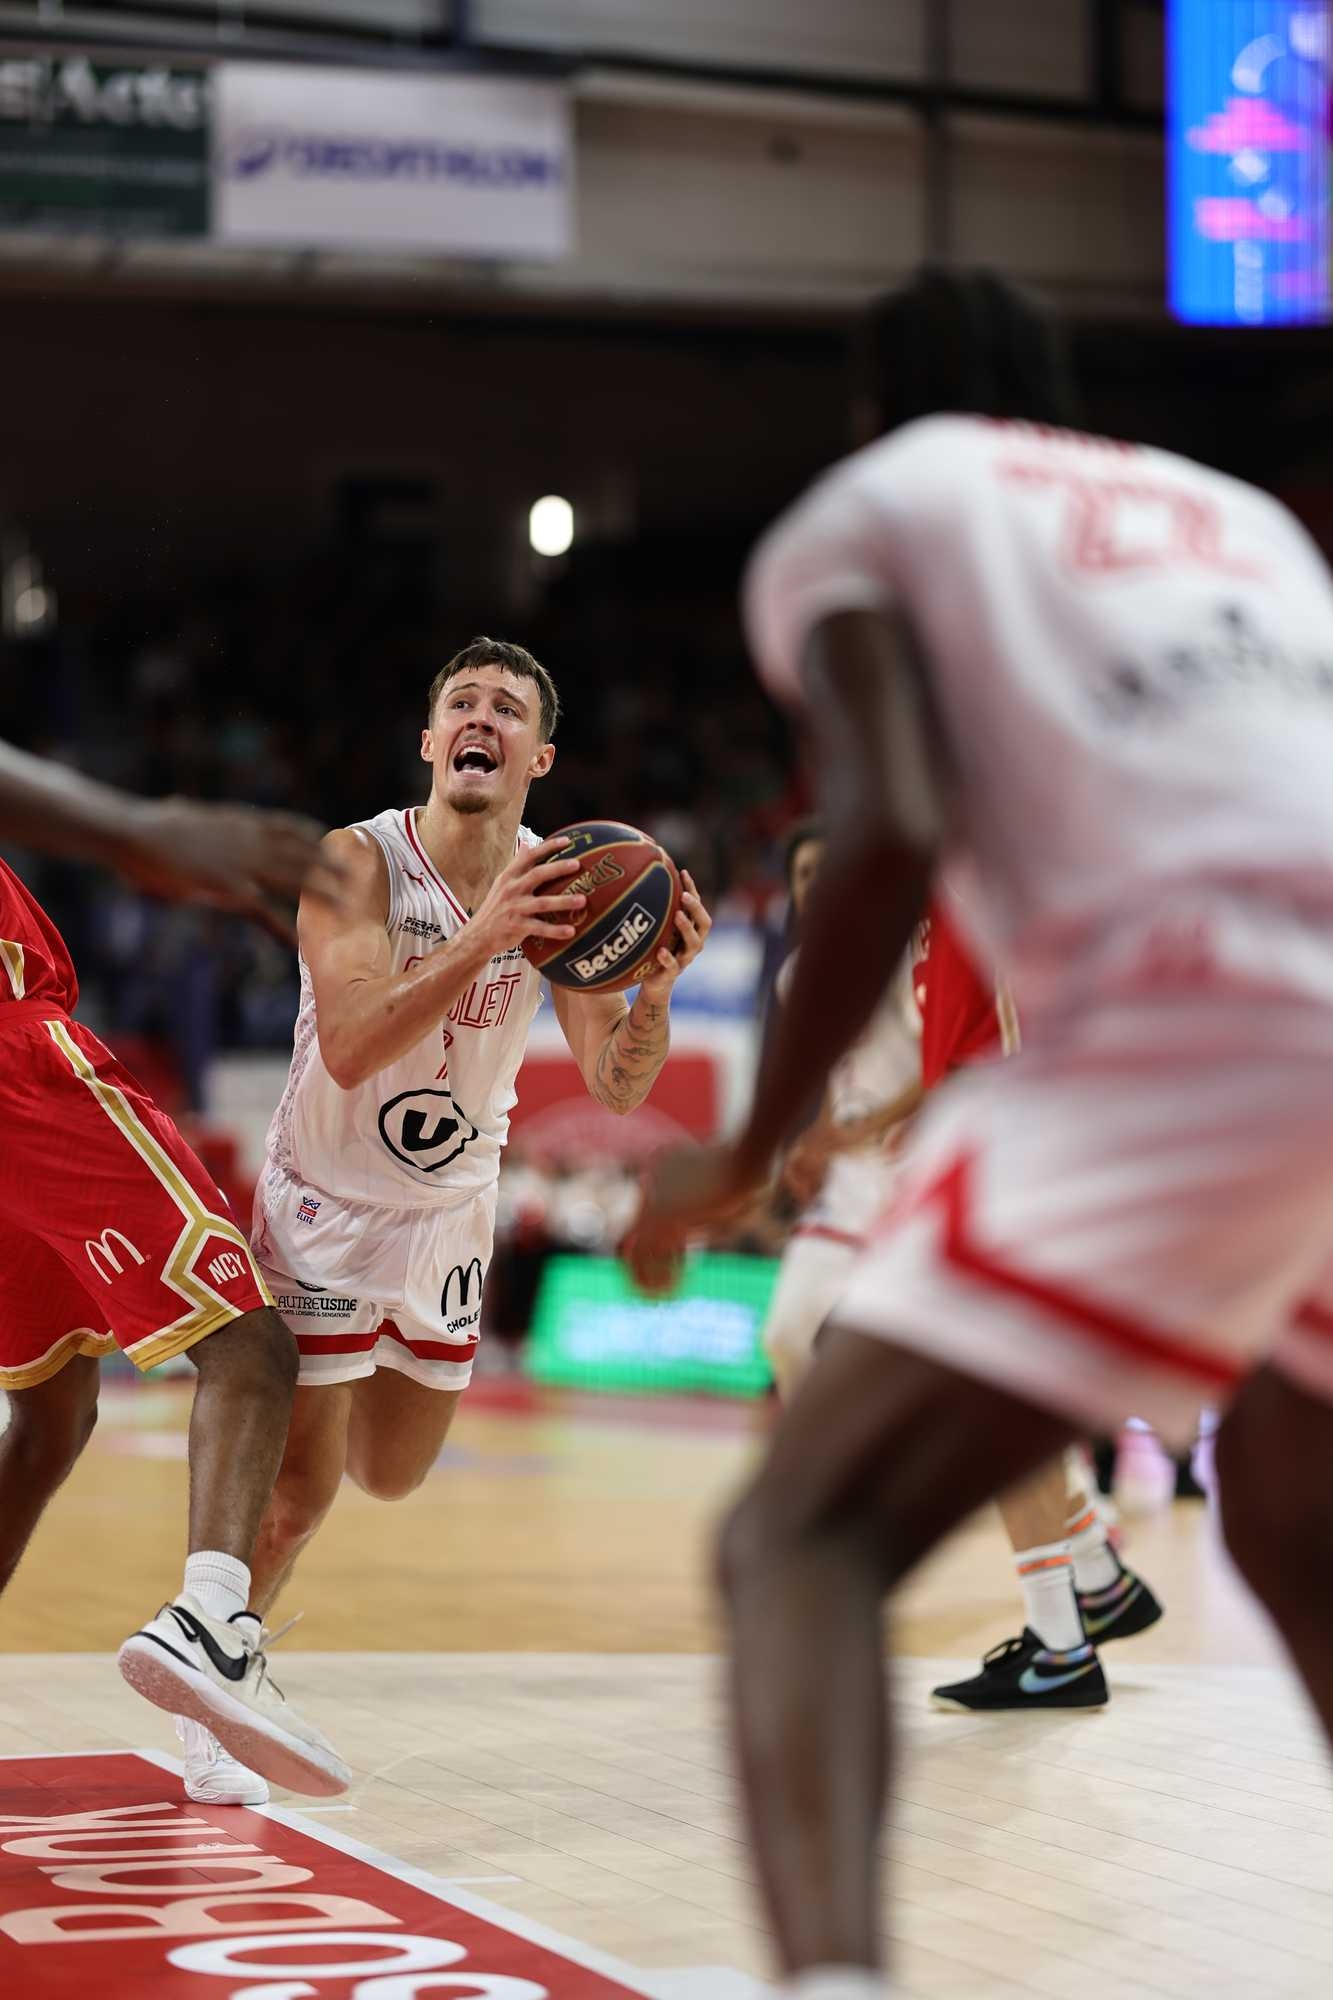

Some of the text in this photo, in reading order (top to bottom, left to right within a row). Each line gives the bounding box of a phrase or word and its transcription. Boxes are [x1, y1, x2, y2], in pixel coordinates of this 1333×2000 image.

[574, 912, 650, 980] Betclic
[296, 1211, 315, 1225] ELITE
[207, 1251, 247, 1286] NCY
